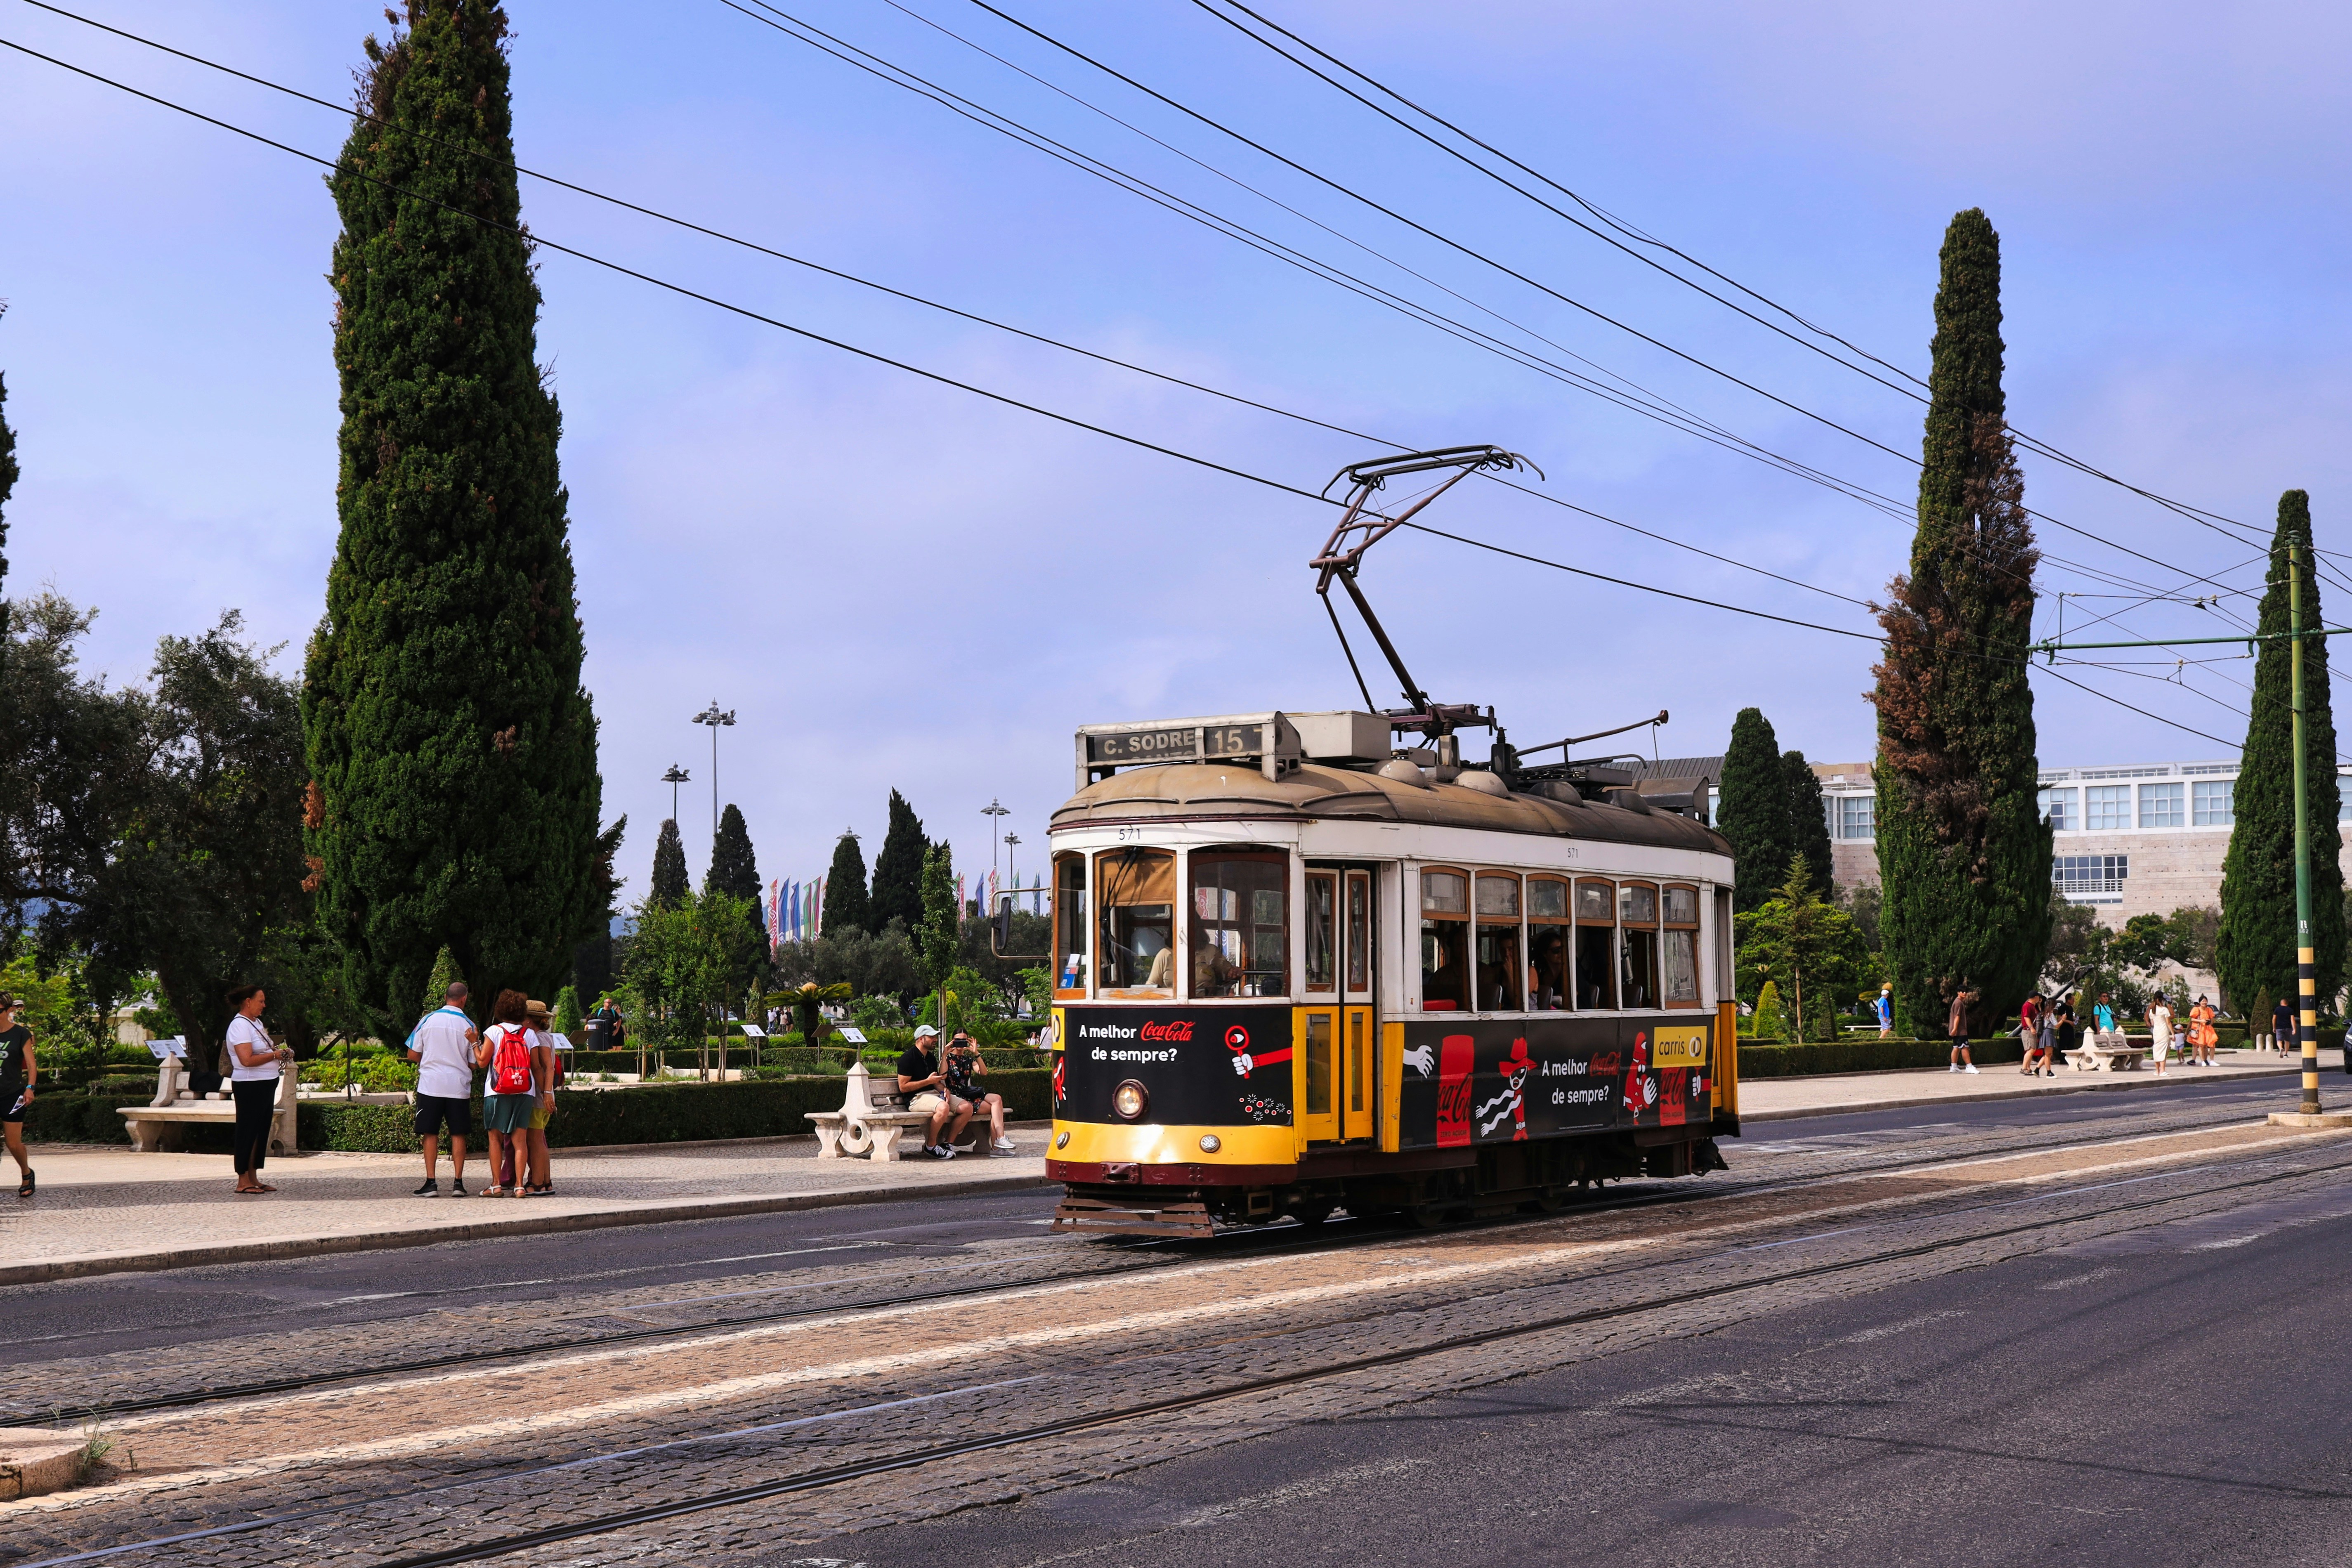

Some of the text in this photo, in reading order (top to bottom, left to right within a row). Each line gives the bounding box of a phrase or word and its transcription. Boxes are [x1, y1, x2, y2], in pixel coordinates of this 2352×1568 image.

[1104, 739, 1122, 755] C.
[1129, 730, 1195, 752] SODRE
[1214, 729, 1243, 753] 15
[1119, 829, 1140, 841] 571
[1568, 848, 1578, 859] 571
[1079, 1021, 1195, 1041] A melhor Coca-Cola
[1091, 1046, 1178, 1064] de sempre?
[1658, 1035, 1685, 1056] carris
[1542, 1060, 1550, 1077] A
[1552, 1058, 1588, 1076] melhor
[1552, 1085, 1609, 1106] de sempre?
